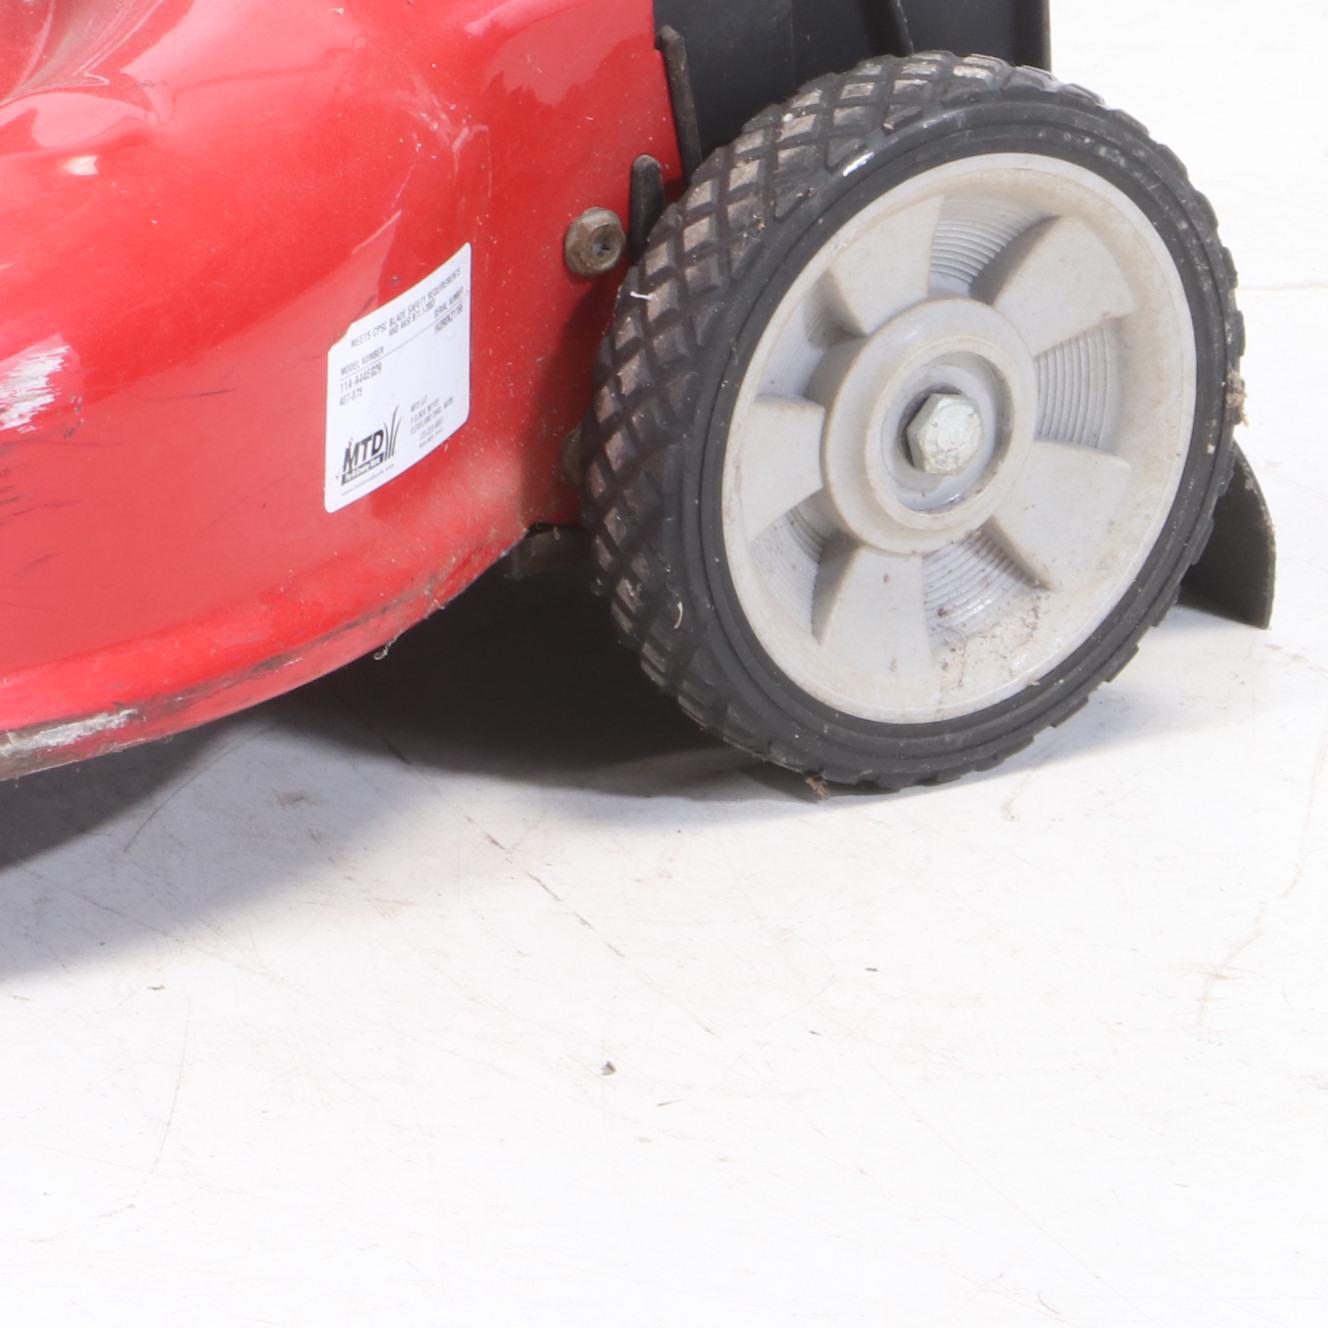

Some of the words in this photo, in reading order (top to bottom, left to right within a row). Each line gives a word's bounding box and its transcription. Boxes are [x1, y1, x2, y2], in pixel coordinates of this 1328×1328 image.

[340, 360, 360, 376] MODEL
[361, 346, 385, 364] NUMBER
[343, 429, 385, 474] MTD
